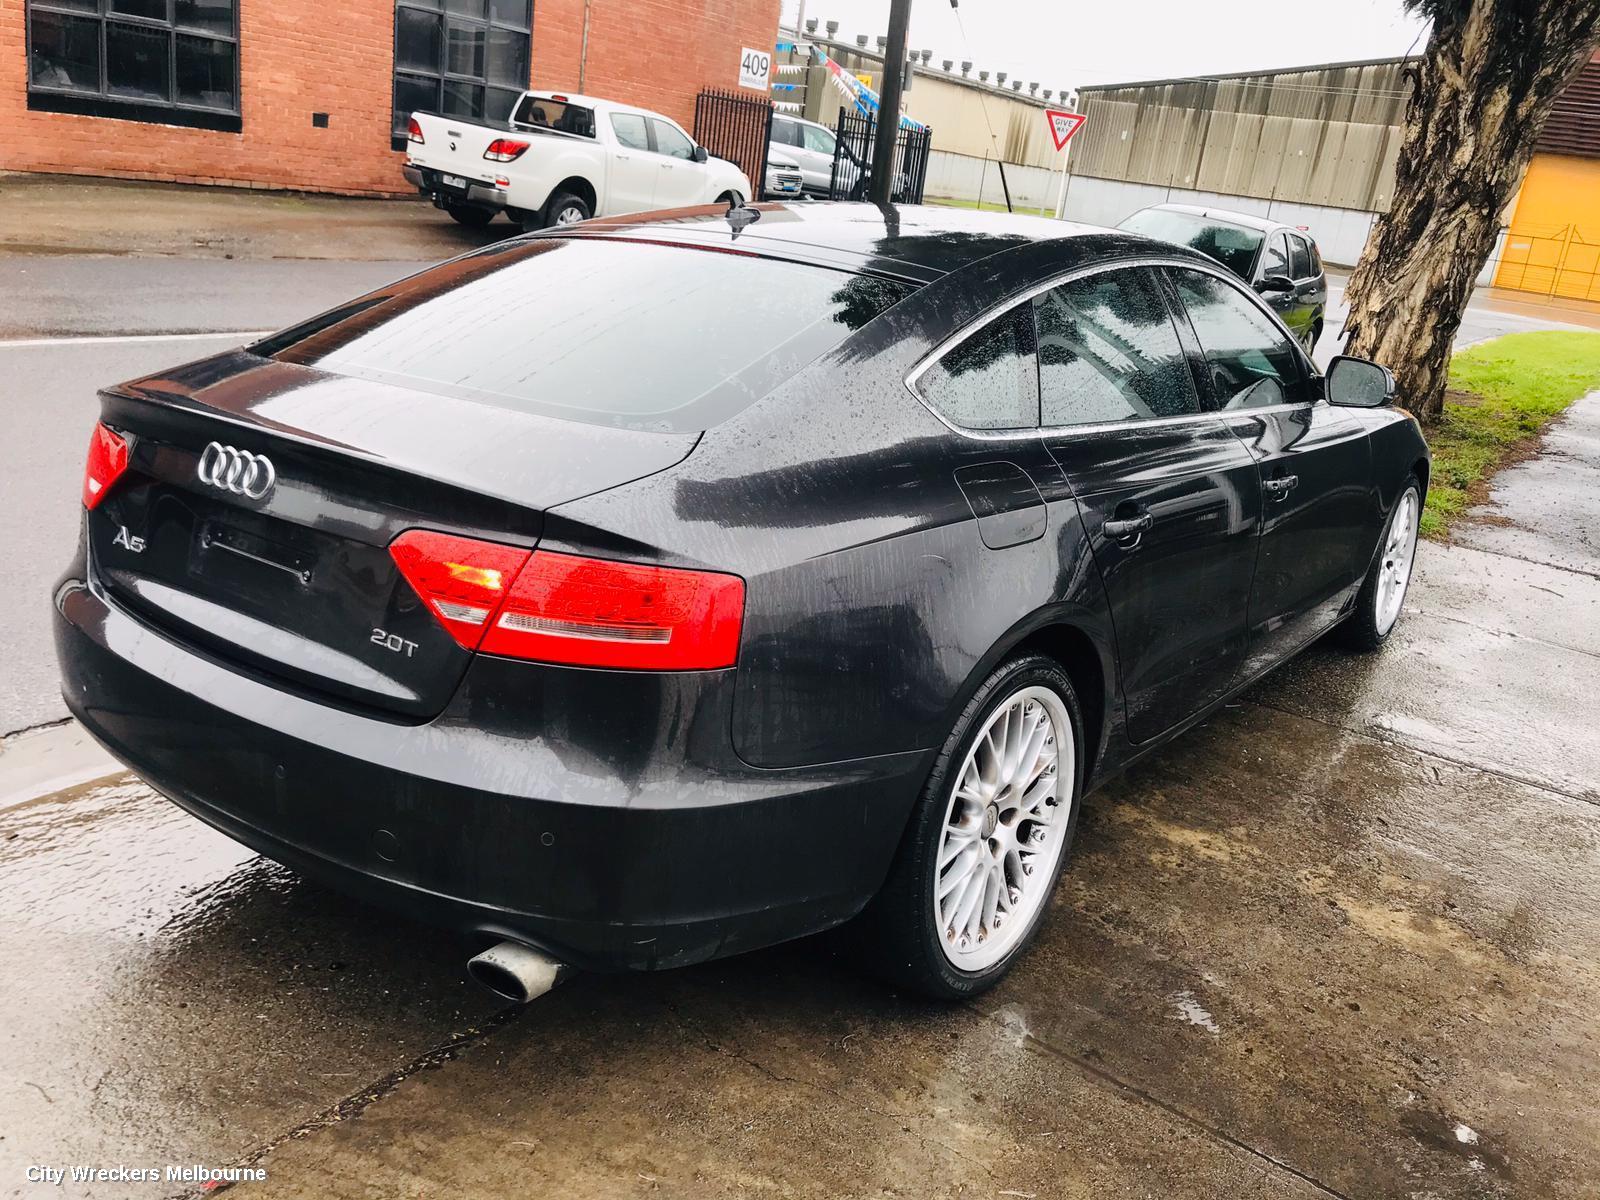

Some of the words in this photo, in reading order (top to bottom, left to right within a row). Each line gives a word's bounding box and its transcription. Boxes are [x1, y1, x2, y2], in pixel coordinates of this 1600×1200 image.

[742, 53, 768, 77] 409
[1055, 118, 1074, 128] GIVE
[112, 526, 146, 553] A5
